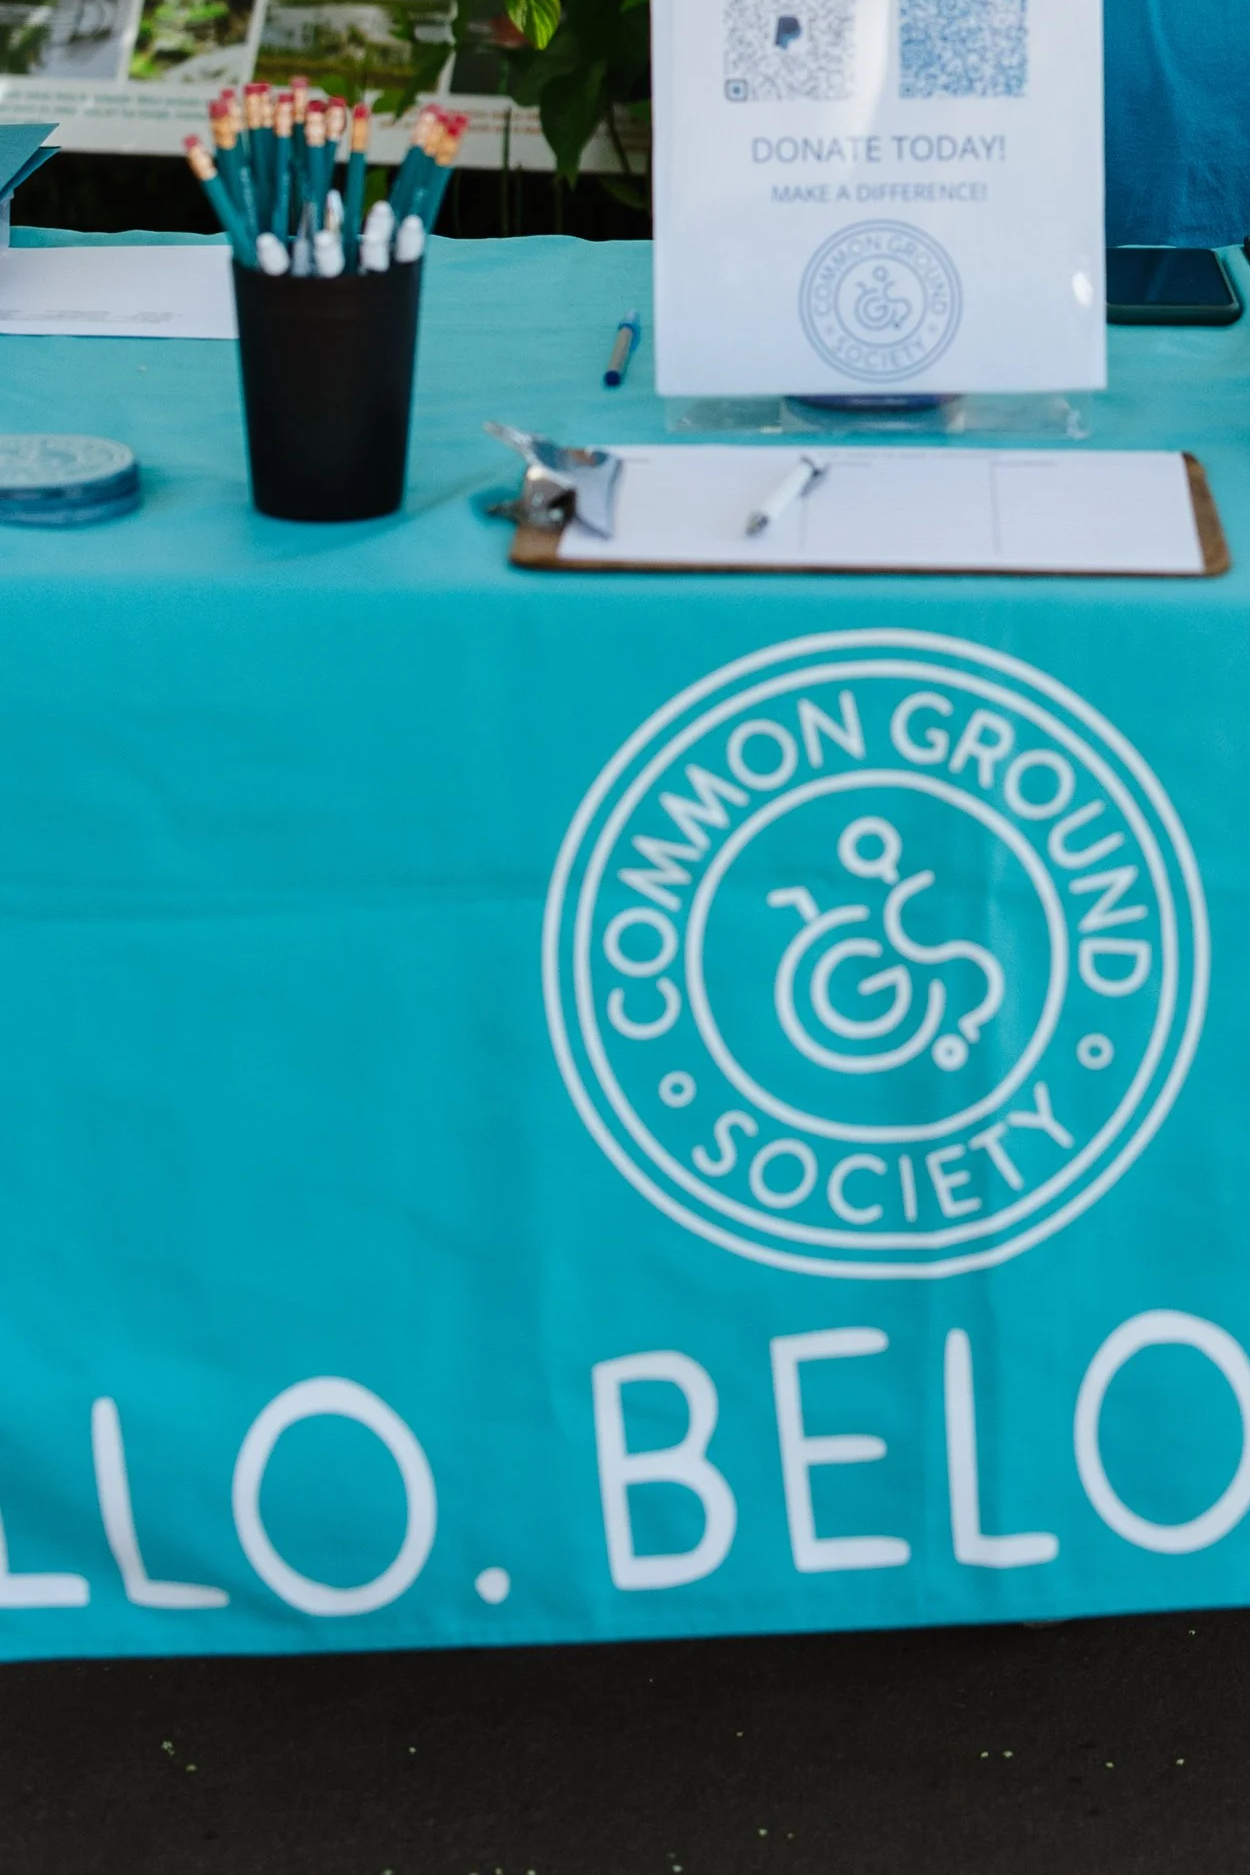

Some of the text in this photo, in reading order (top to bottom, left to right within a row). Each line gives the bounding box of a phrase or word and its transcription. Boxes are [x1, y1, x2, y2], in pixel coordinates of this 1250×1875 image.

[752, 134, 1006, 164] DONATE TODAY!
[771, 182, 988, 203] MAKE A DIFFERENCE!
[813, 235, 948, 317] COMMON GROUND
[832, 335, 928, 368] SOCIETY
[606, 688, 1153, 1041] COMMON GROUND
[691, 1082, 1076, 1225] SOCIETY
